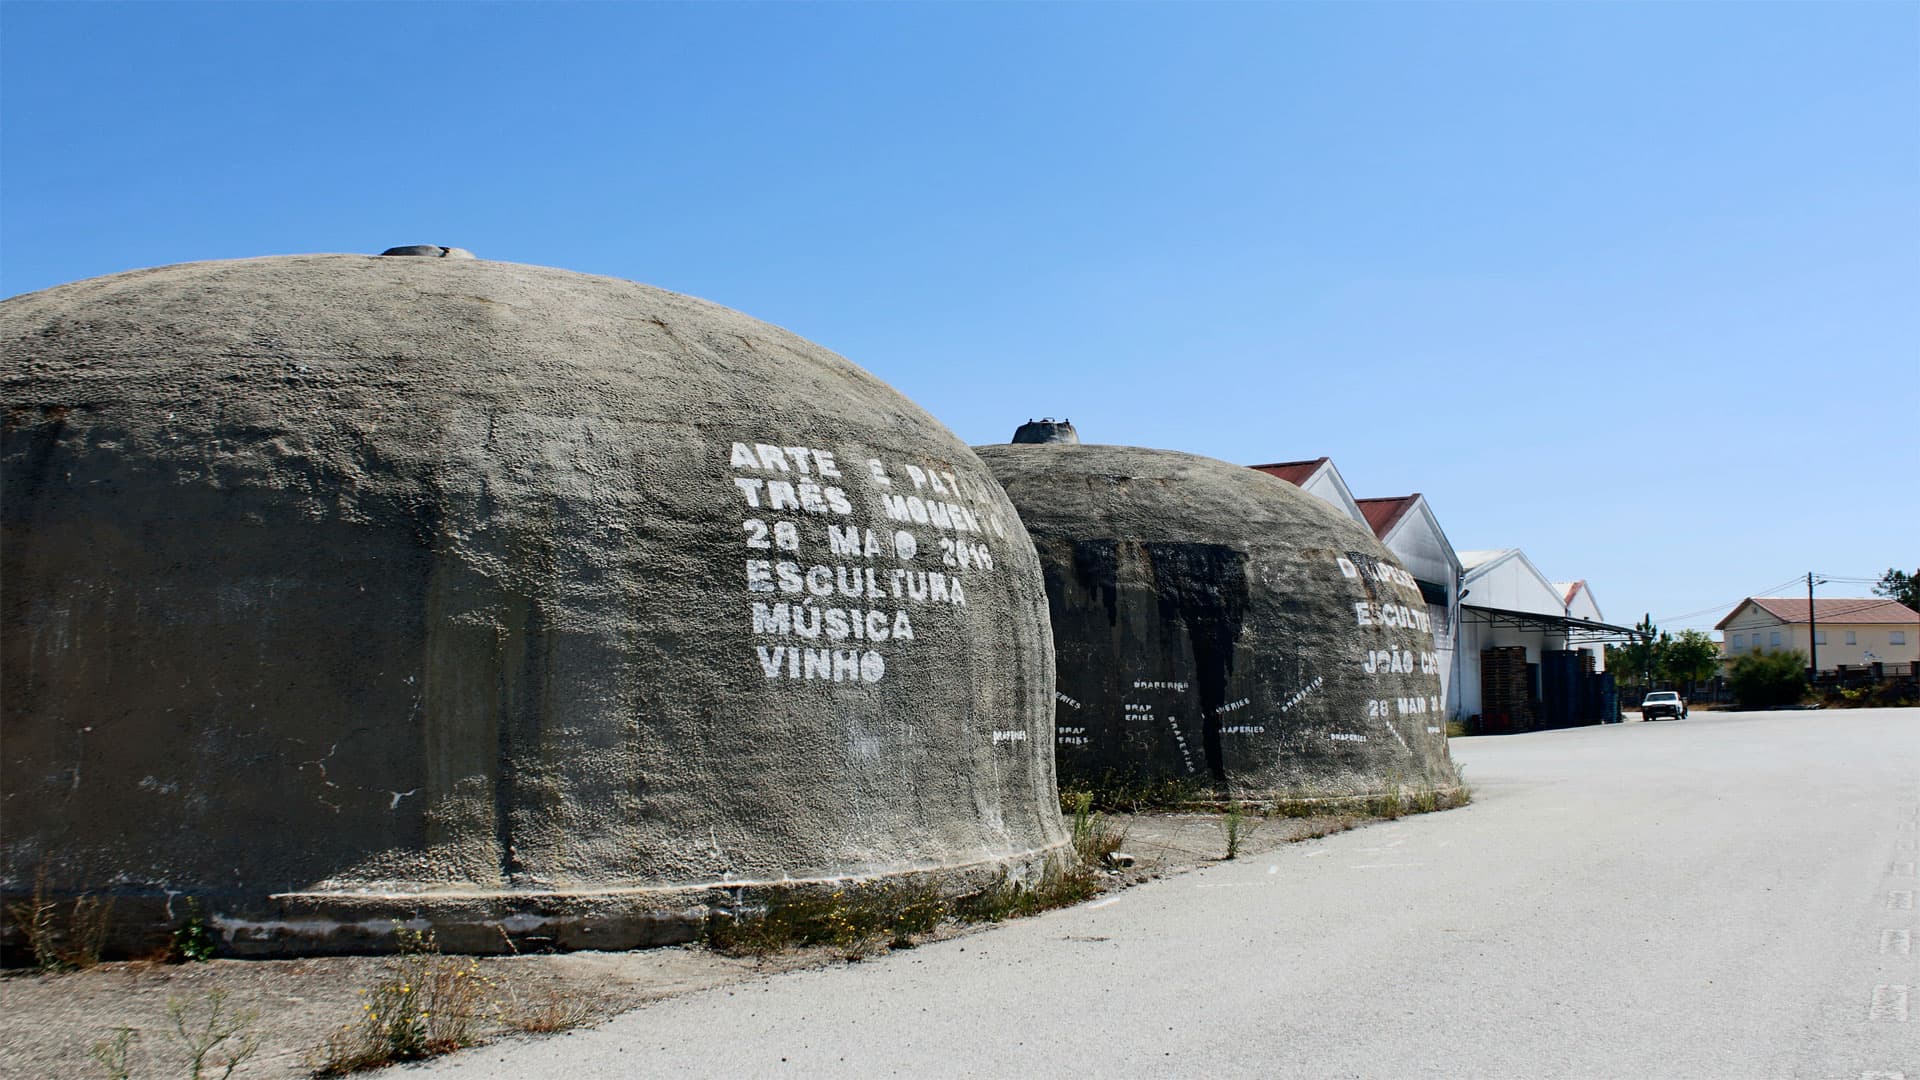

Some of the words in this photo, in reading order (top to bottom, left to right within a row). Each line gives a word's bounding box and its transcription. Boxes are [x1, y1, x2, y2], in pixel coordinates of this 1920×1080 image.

[730, 442, 841, 478] ARTE
[868, 458, 891, 485] E
[734, 477, 852, 515] TRÊS
[743, 518, 799, 550] 28
[828, 524, 917, 560] MAIO
[746, 559, 966, 607] ESCULTURA
[752, 597, 915, 642] MÚSICA
[756, 645, 886, 683] VINHO
[1364, 644, 1414, 674] JOÃO
[1055, 691, 1081, 711] ERIES
[1124, 703, 1152, 713] DRAP
[1124, 714, 1155, 722] ERIES
[1368, 699, 1389, 717] 28
